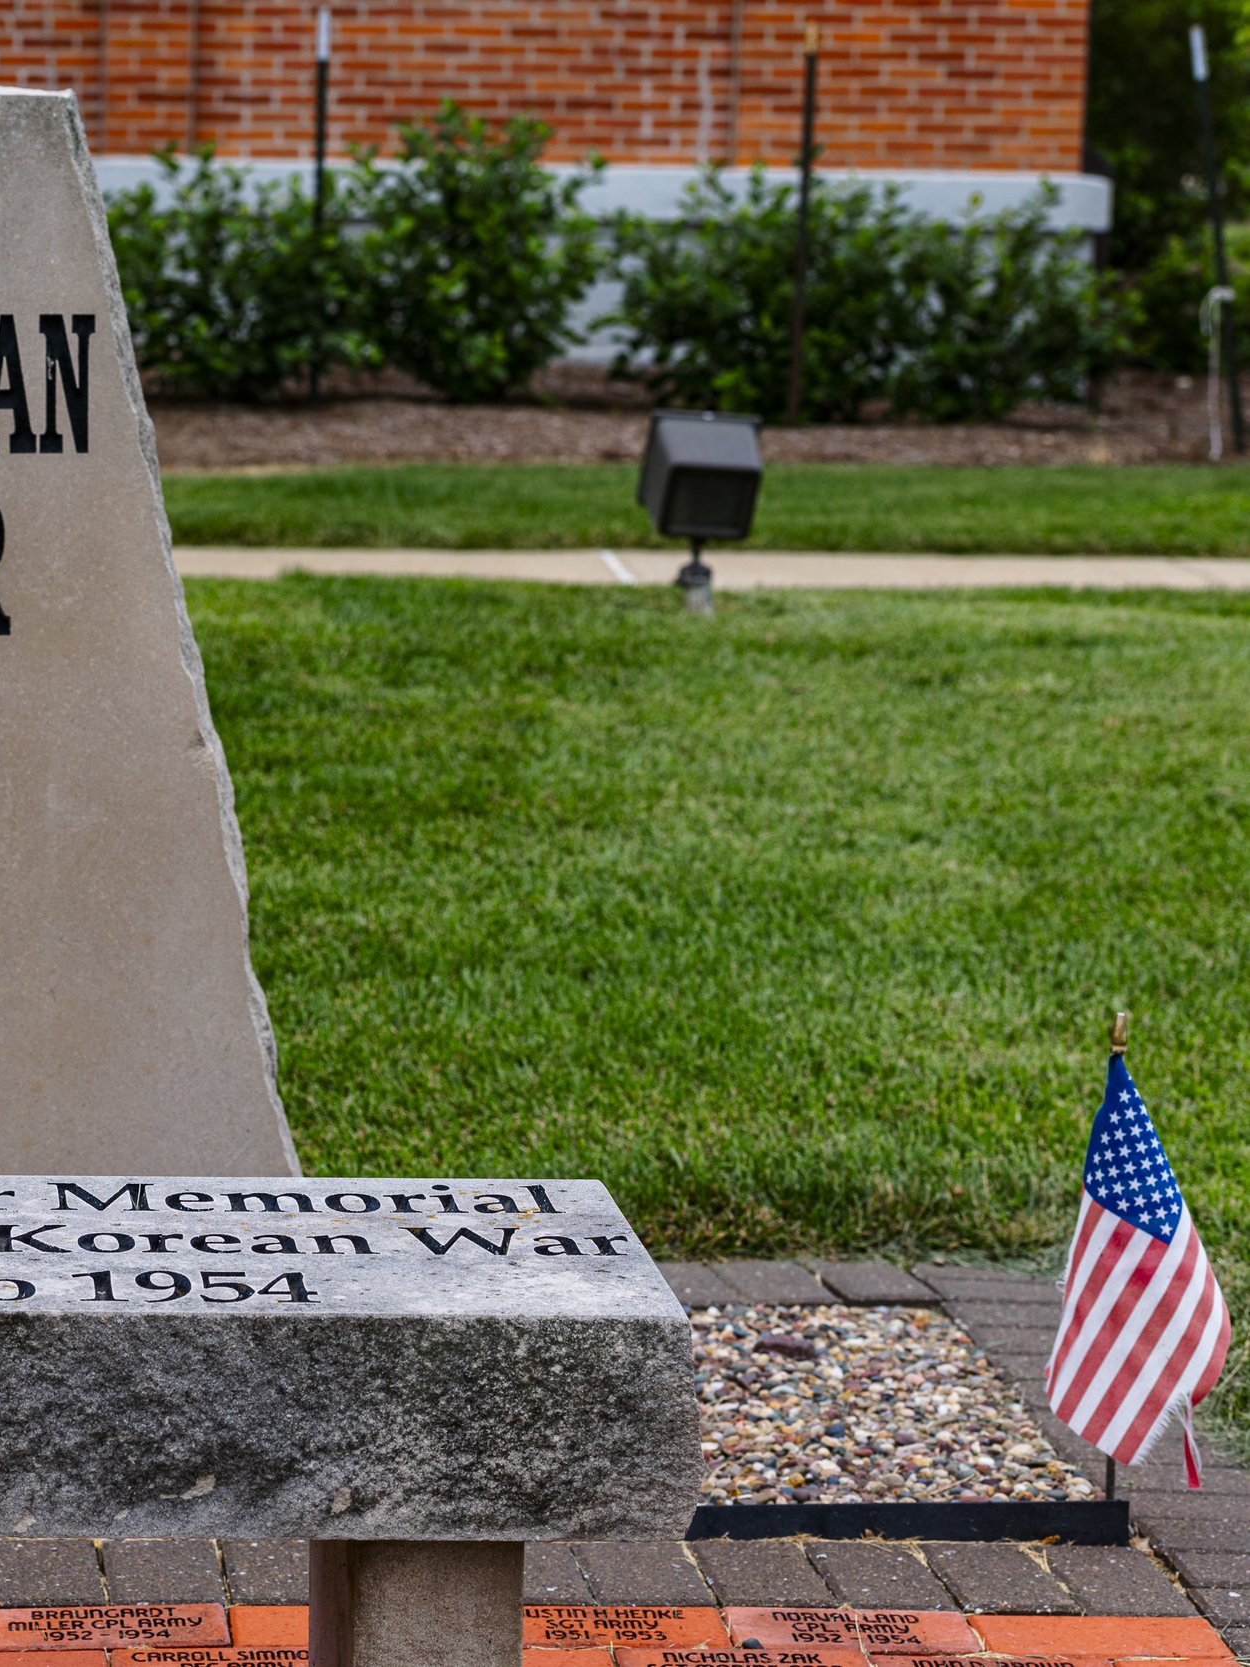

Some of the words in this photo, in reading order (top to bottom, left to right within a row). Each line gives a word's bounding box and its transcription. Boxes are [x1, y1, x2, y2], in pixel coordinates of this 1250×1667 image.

[47, 1182, 563, 1214] Memorial
[399, 1226, 628, 1257] War
[71, 1270, 321, 1304] 1954
[31, 1607, 176, 1620] BRAUNGARDT
[522, 1608, 587, 1619] USTIN
[592, 1609, 609, 1619] H
[615, 1609, 686, 1620] HENKE
[772, 1611, 855, 1623] NORVAL
[862, 1613, 920, 1624] LAND
[8, 1620, 85, 1632] MILLER
[91, 1619, 131, 1630] CPL
[138, 1616, 203, 1628] ARMY
[545, 1619, 584, 1630] SGT
[594, 1619, 659, 1630] ARMY
[845, 1623, 910, 1635] ARMY
[42, 1630, 94, 1642] 1952
[118, 1629, 172, 1640] 1954
[544, 1630, 590, 1641] 1951
[615, 1630, 668, 1642] 1953
[791, 1632, 844, 1644] 1952
[867, 1634, 922, 1645] 1954
[131, 1651, 231, 1663] CARROLL
[662, 1652, 772, 1665] NICHOLAS
[777, 1653, 823, 1665] ZAK
